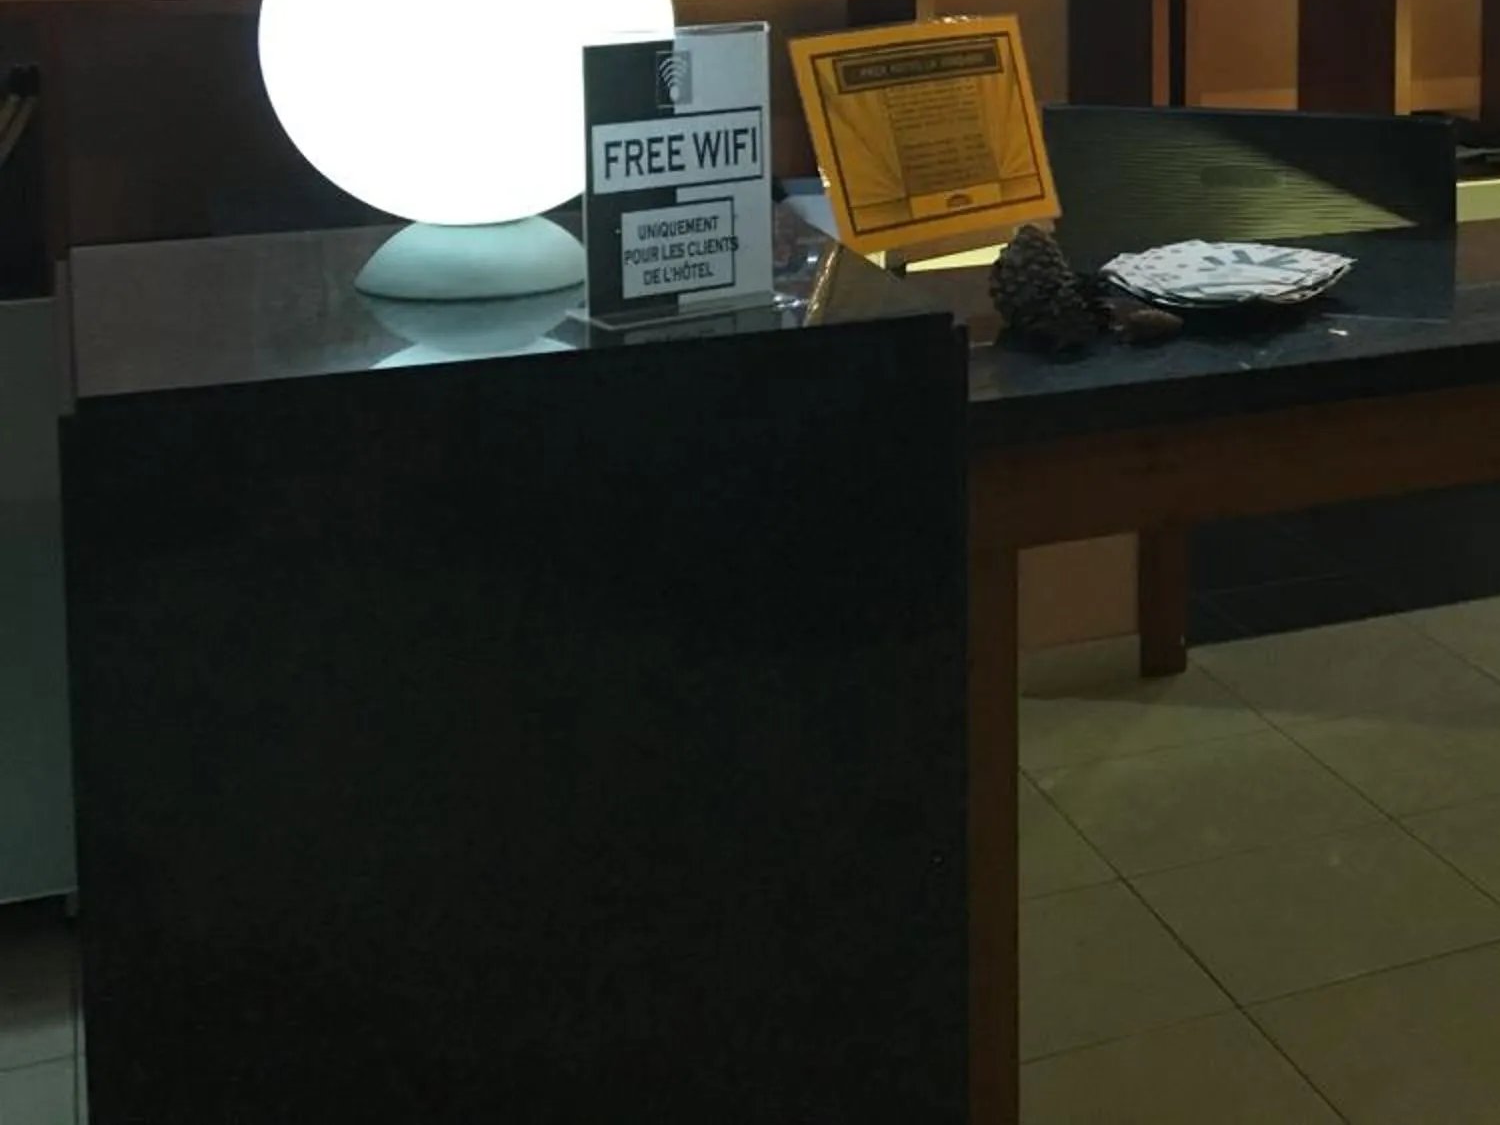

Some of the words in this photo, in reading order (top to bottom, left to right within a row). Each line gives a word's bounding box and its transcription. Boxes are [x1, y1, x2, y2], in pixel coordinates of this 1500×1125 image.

[603, 132, 686, 181] FREE
[692, 126, 758, 169] WIFI
[637, 215, 719, 241] UNIQUEMENT
[624, 245, 660, 266] POUR
[660, 242, 685, 261] LES
[687, 235, 740, 258] CLIENTS
[643, 266, 662, 285] DE
[662, 260, 715, 283] L'HÔTEL
